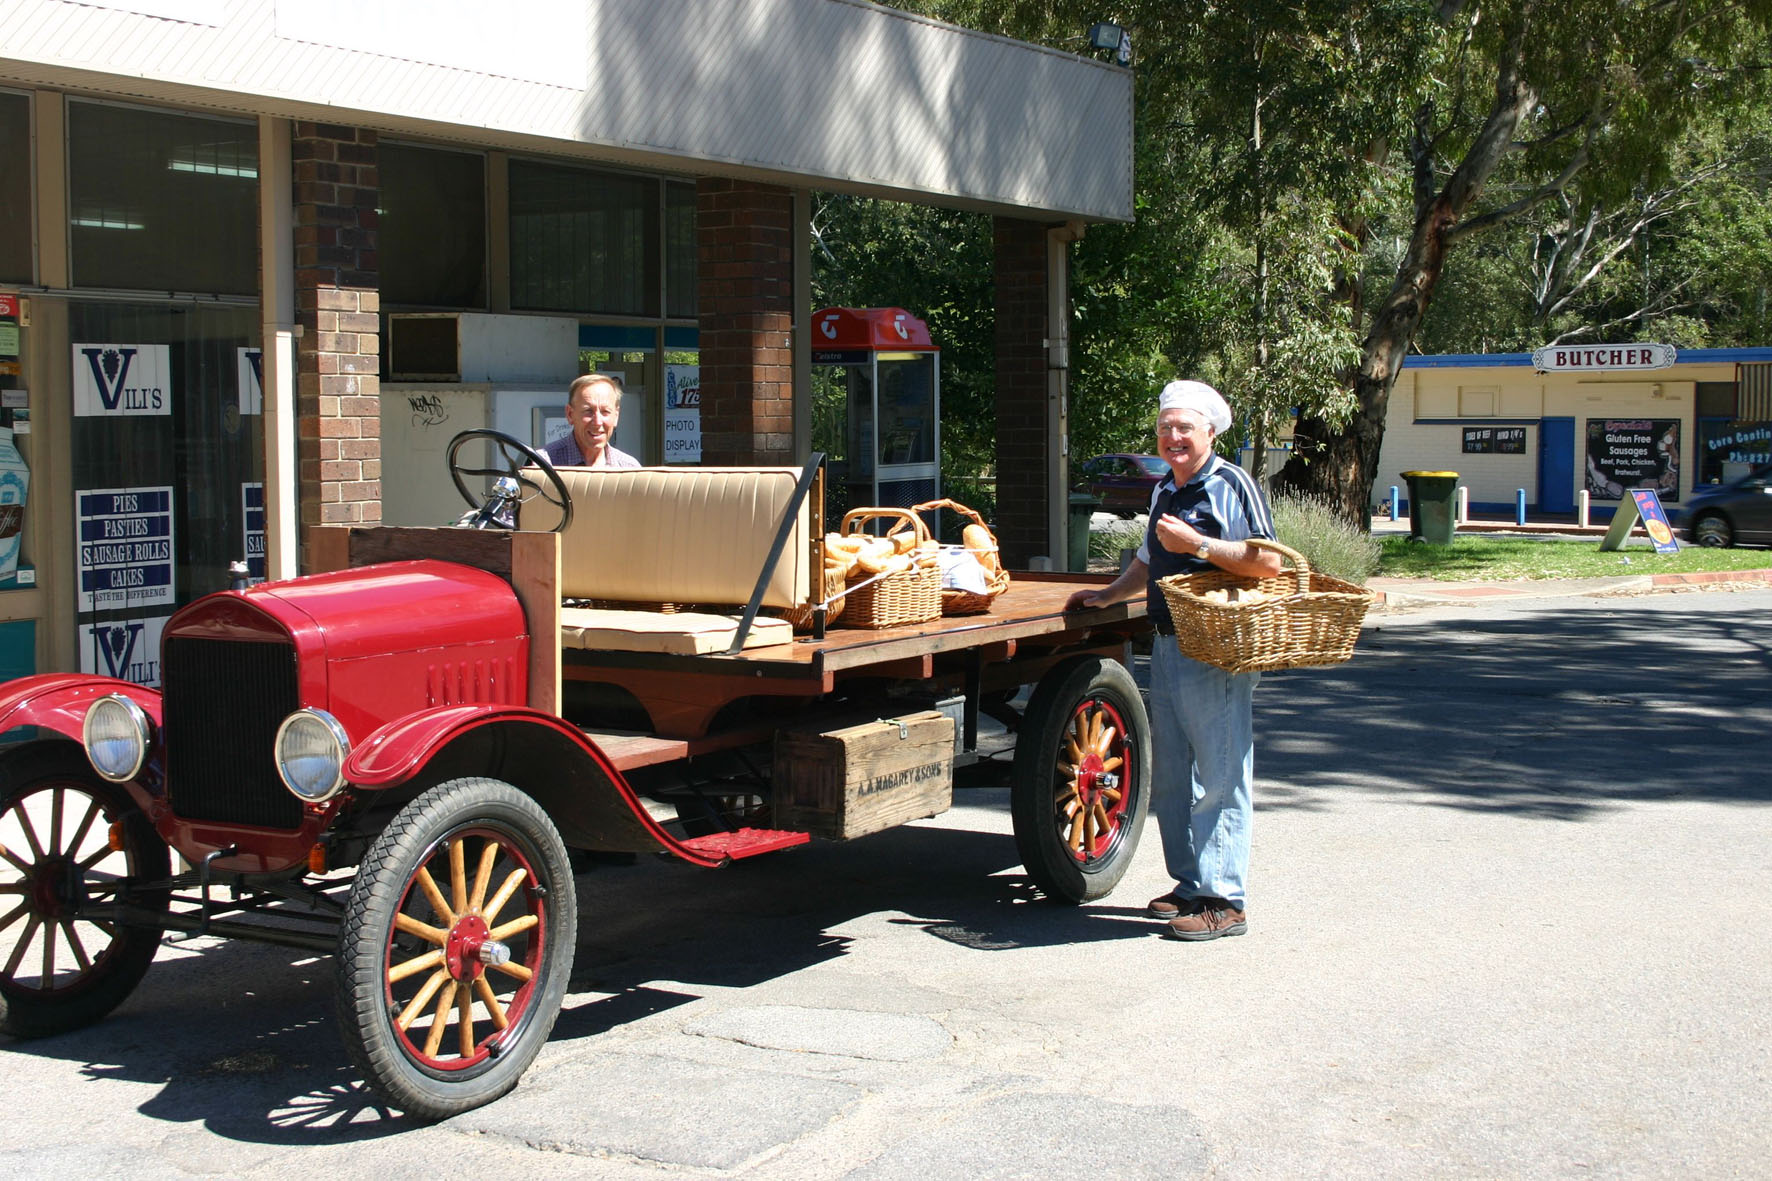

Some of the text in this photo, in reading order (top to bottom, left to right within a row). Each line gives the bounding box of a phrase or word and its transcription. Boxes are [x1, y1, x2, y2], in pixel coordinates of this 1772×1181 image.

[1556, 350, 1653, 366] BUTCHER
[82, 348, 162, 410] VILI'S
[666, 420, 694, 431] PHOTO
[666, 440, 699, 451] DISPLAY
[1605, 433, 1652, 444] Gluten Free
[1708, 436, 1733, 450] Coro
[1609, 446, 1648, 458] Sausages
[1600, 458, 1656, 466] Beef, Pork, Chicken,
[113, 494, 138, 513] PIES
[104, 518, 148, 537] PASTIES
[83, 541, 169, 565] SAUSAGE ROLLS
[111, 568, 144, 588] CAKES
[88, 587, 167, 603] TASTE THE DIFFERENCE
[89, 624, 161, 683] VILI'
